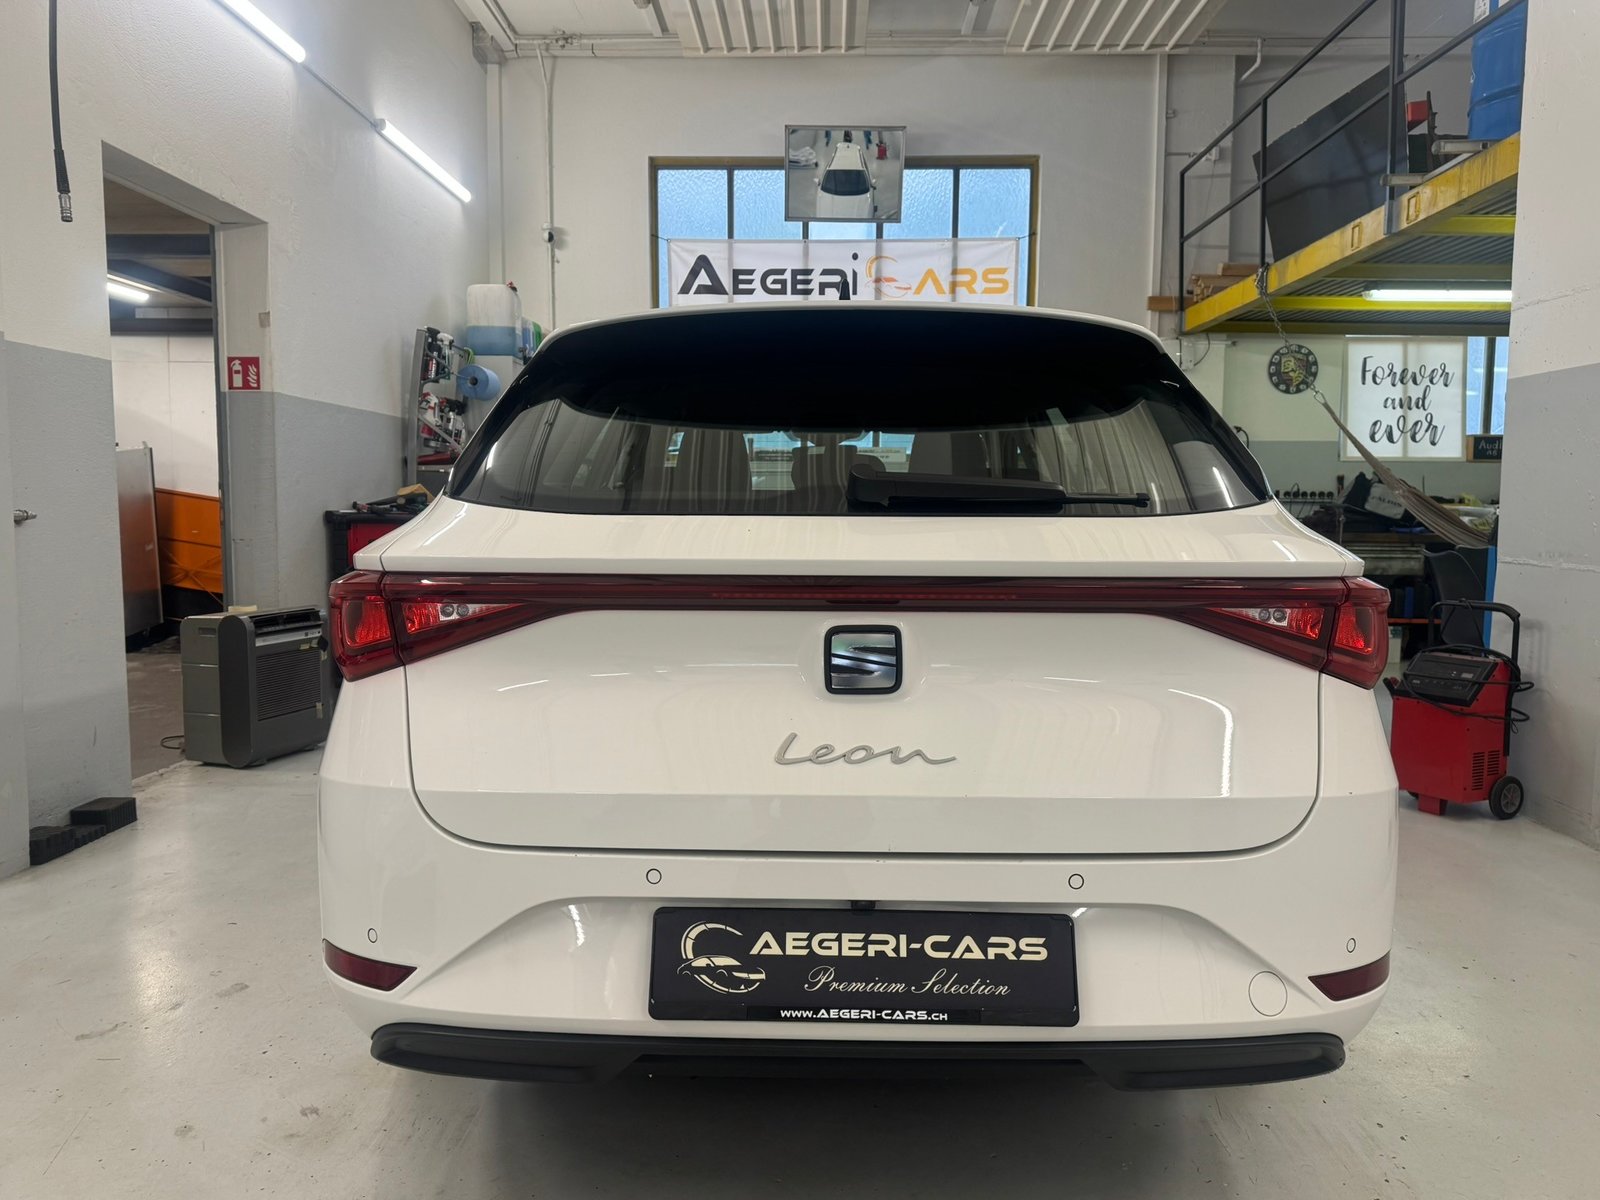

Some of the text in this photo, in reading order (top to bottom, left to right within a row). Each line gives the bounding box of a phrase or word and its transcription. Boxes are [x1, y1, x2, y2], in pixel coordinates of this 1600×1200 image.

[1361, 356, 1454, 388] Forever
[1383, 385, 1432, 411] and
[1369, 412, 1446, 447] ever
[774, 732, 957, 765] Leon
[749, 931, 1048, 961] AEGERI-CARS
[804, 965, 1011, 997] Premium Selection
